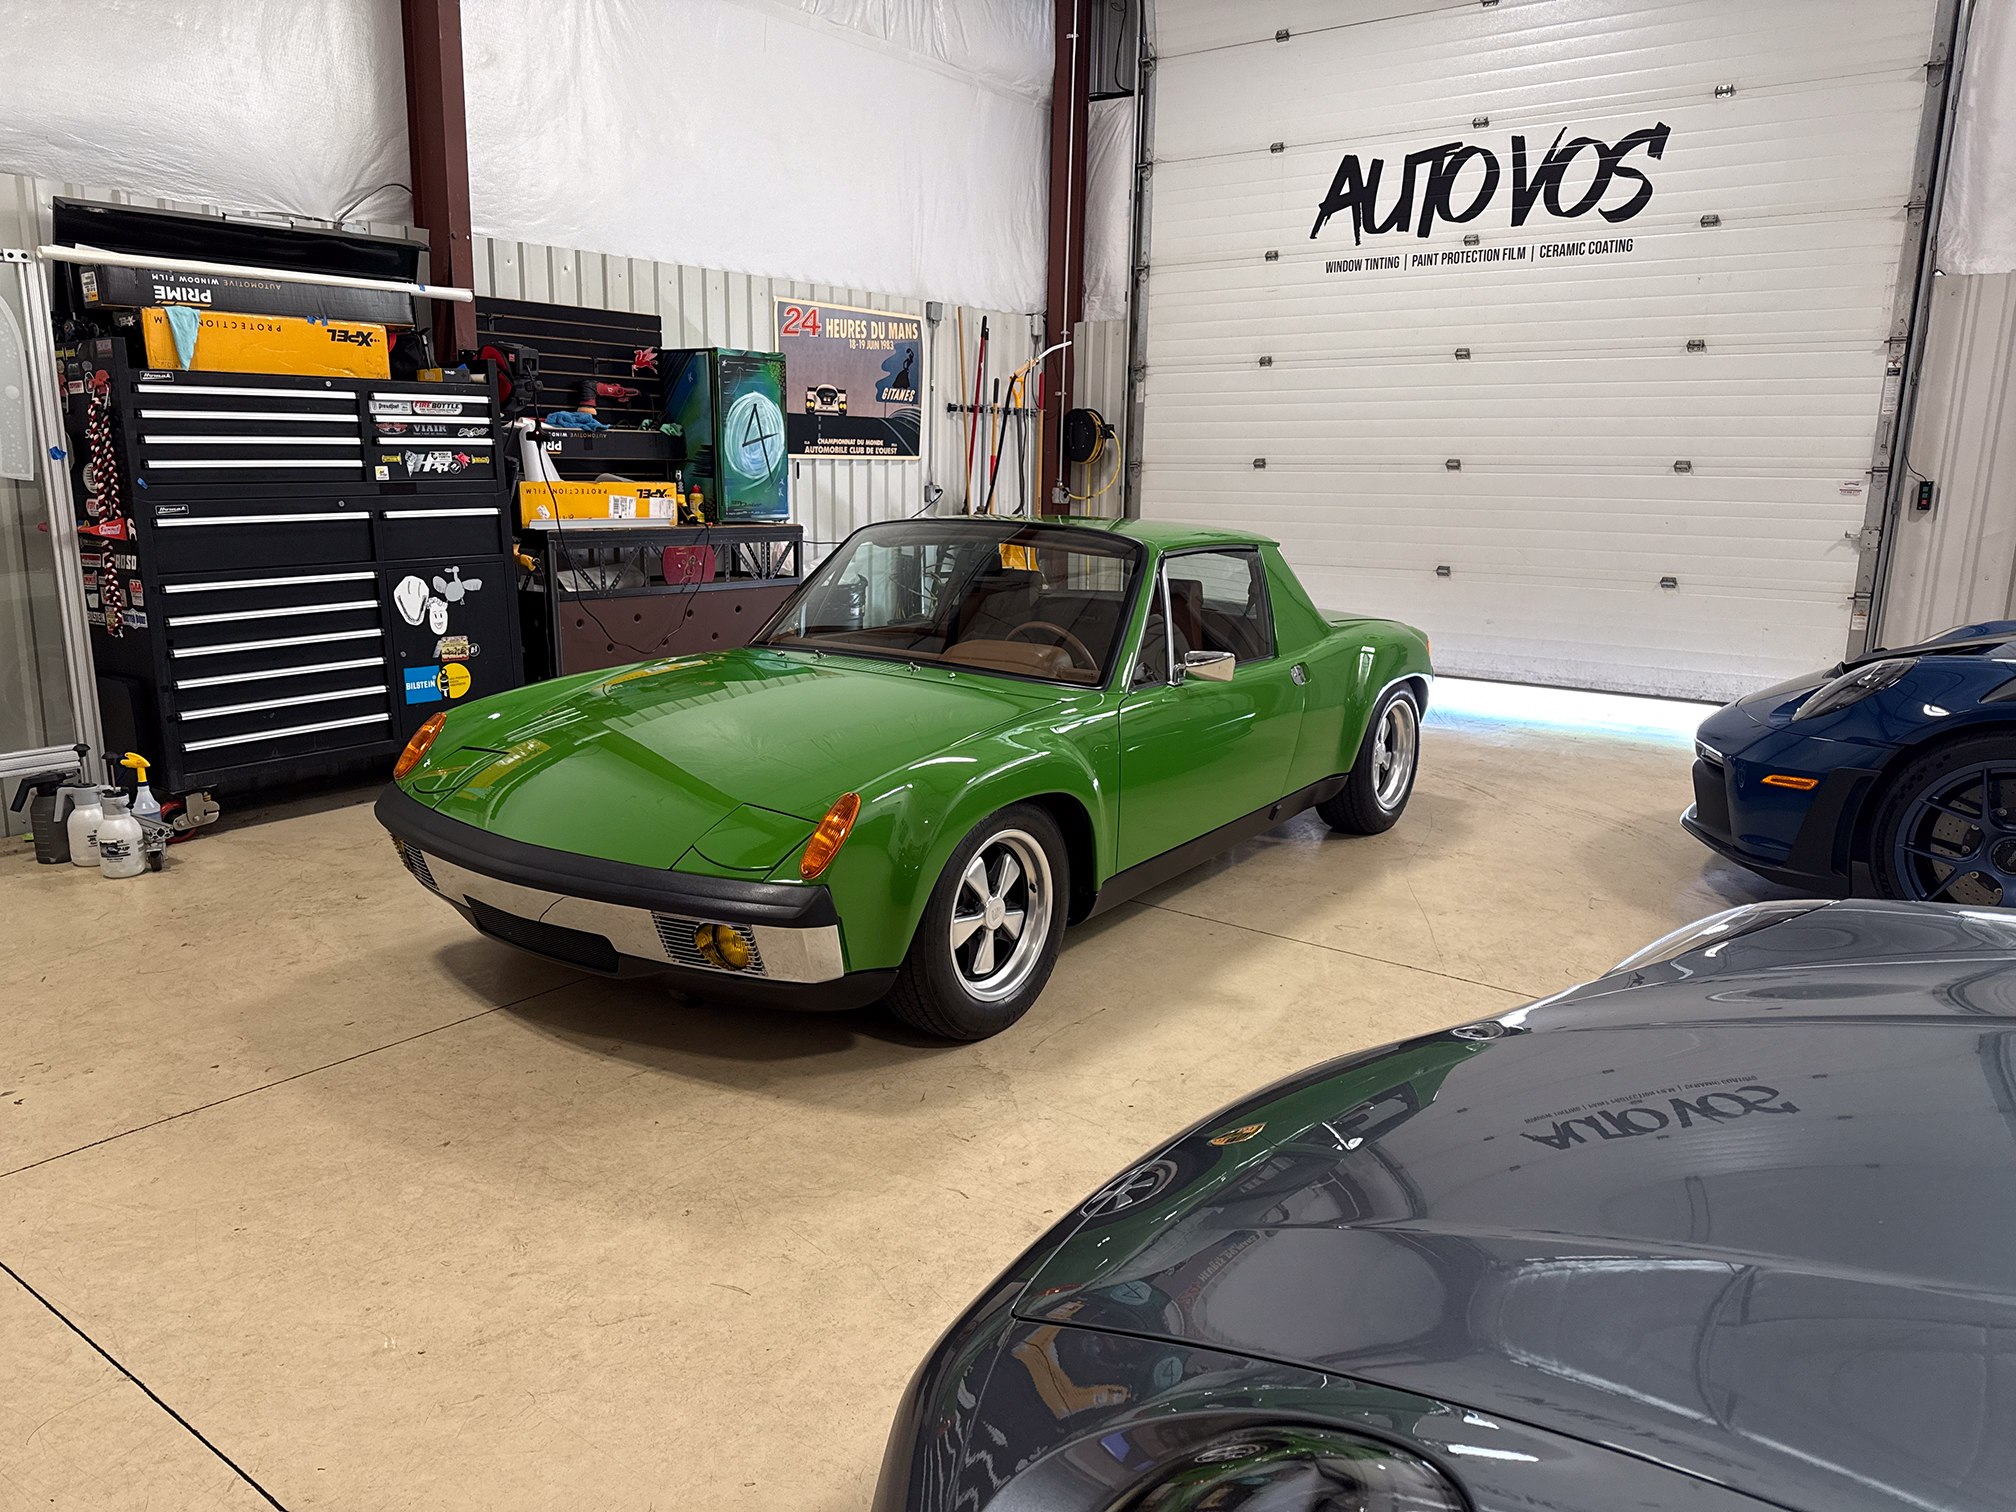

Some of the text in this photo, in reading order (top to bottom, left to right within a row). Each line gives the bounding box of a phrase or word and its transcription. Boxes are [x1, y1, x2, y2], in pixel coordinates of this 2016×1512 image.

[1309, 121, 1671, 246] AUTO VOS
[1325, 238, 1634, 274] WINDOW TINTING PAINT PROTECTION FILM CERAMIC COATING
[151, 273, 282, 290] AUTOMOTIVE WINDOW FILM
[153, 285, 212, 303] PRIME
[781, 305, 919, 340] 24 HEURES DU MANS
[326, 328, 373, 347] XPEL
[848, 339, 866, 350] 18-19
[866, 340, 880, 350] JUIN
[881, 387, 916, 402] GITANES
[413, 424, 447, 433] VIAIR
[804, 445, 848, 454] AUTOMOBILE
[849, 446, 865, 454] CLUB
[875, 447, 898, 455] L'OUEST
[636, 488, 668, 499] XPEL
[405, 680, 436, 691] BILSTEIN
